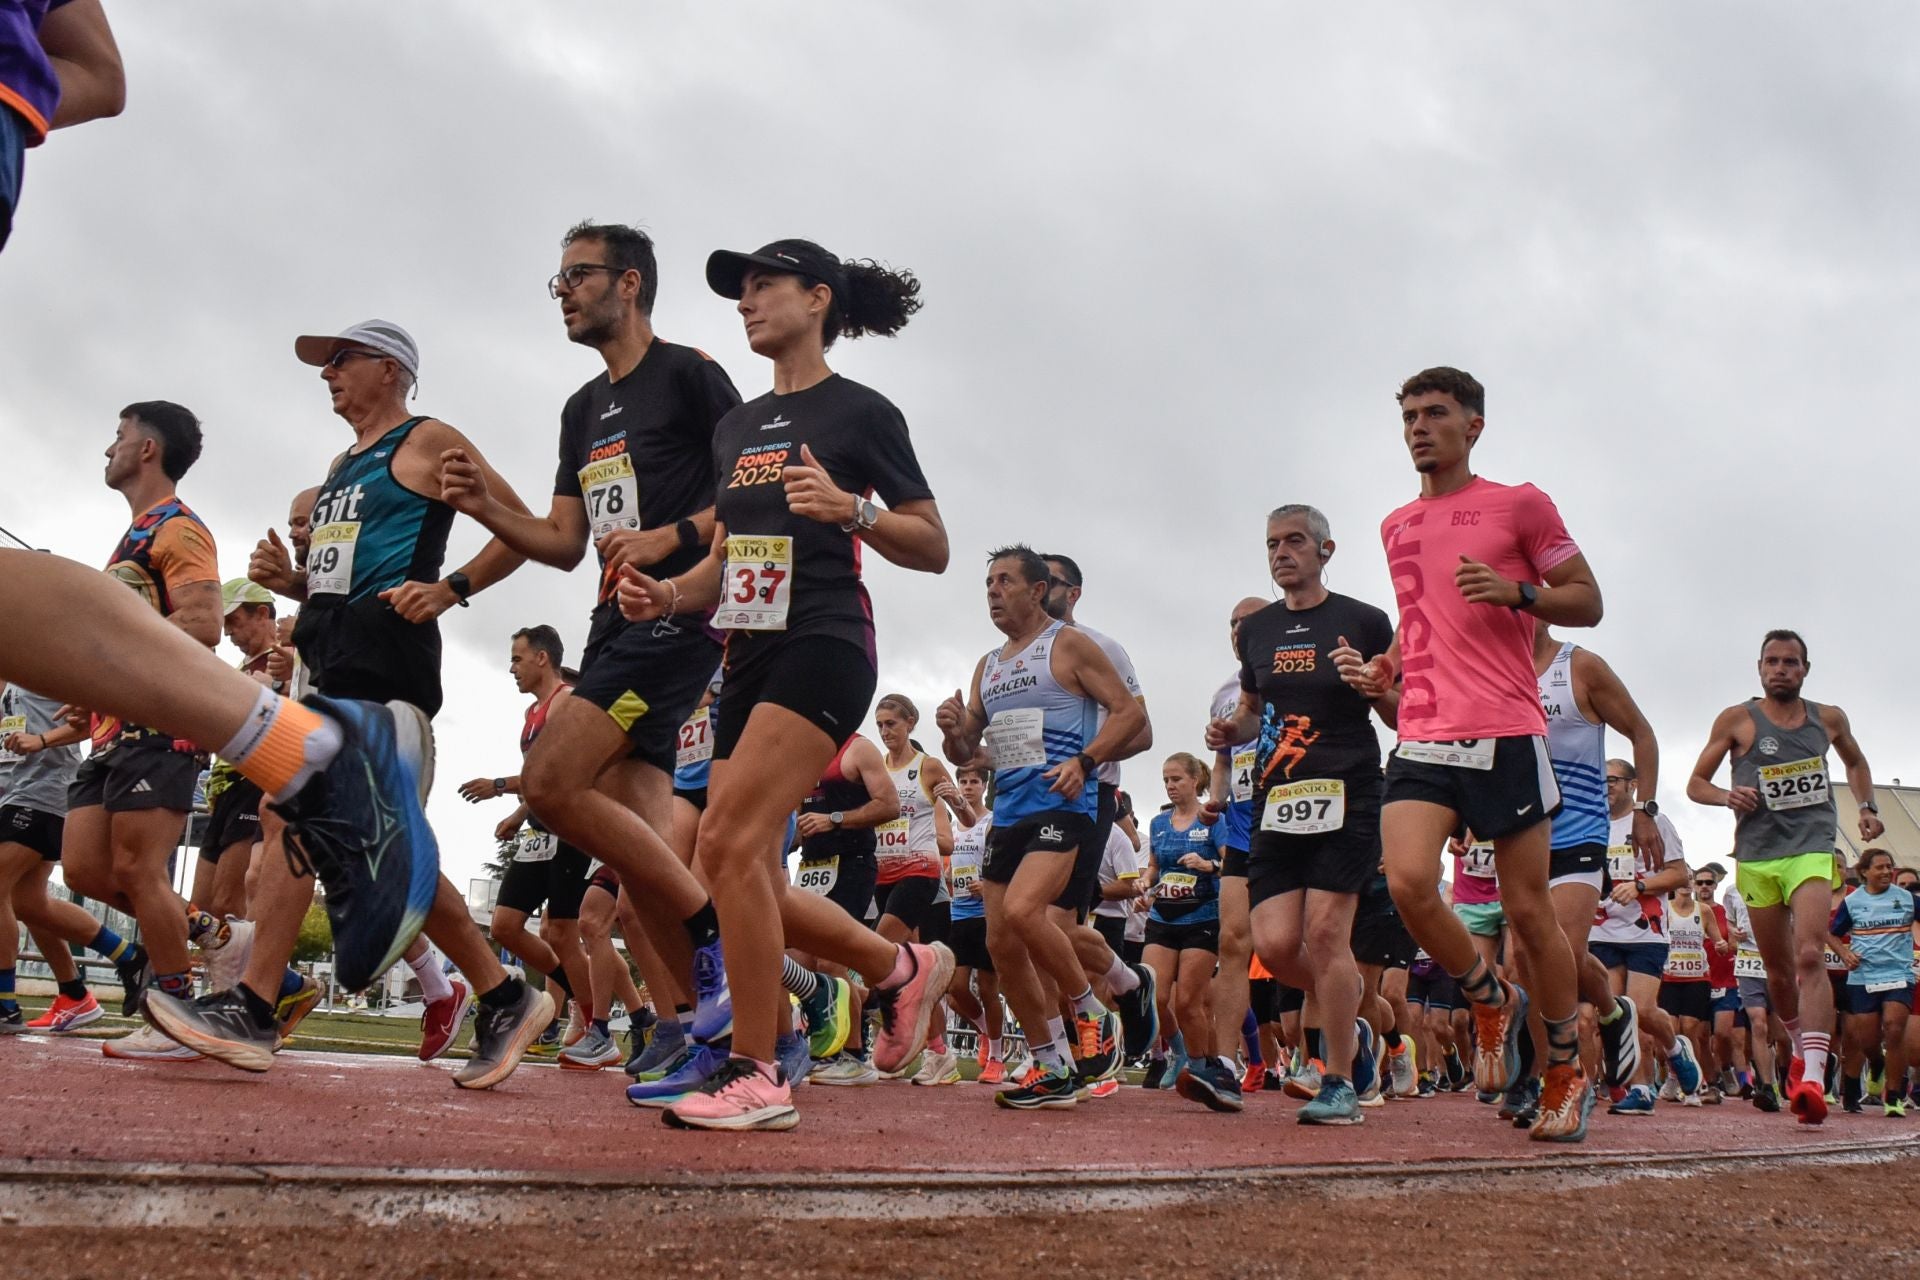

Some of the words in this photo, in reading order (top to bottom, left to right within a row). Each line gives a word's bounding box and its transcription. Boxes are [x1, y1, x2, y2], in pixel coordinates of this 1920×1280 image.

[592, 438, 607, 449] GRAN
[607, 430, 627, 445] PREMIO
[742, 446, 762, 455] GRAN
[762, 441, 792, 452] PREMIO
[589, 440, 626, 461] FONDO
[735, 450, 789, 469] FONDO
[727, 462, 784, 489] 2025
[588, 484, 624, 519] 78
[1451, 510, 1480, 526] BCC
[307, 546, 339, 575] 49
[1274, 649, 1316, 660] FONDO
[1272, 658, 1316, 673] 2025
[1766, 773, 1826, 799] 3262
[1277, 799, 1332, 824] 997
[1039, 823, 1064, 842] als
[800, 870, 831, 888] 966
[1670, 960, 1702, 971] 2105
